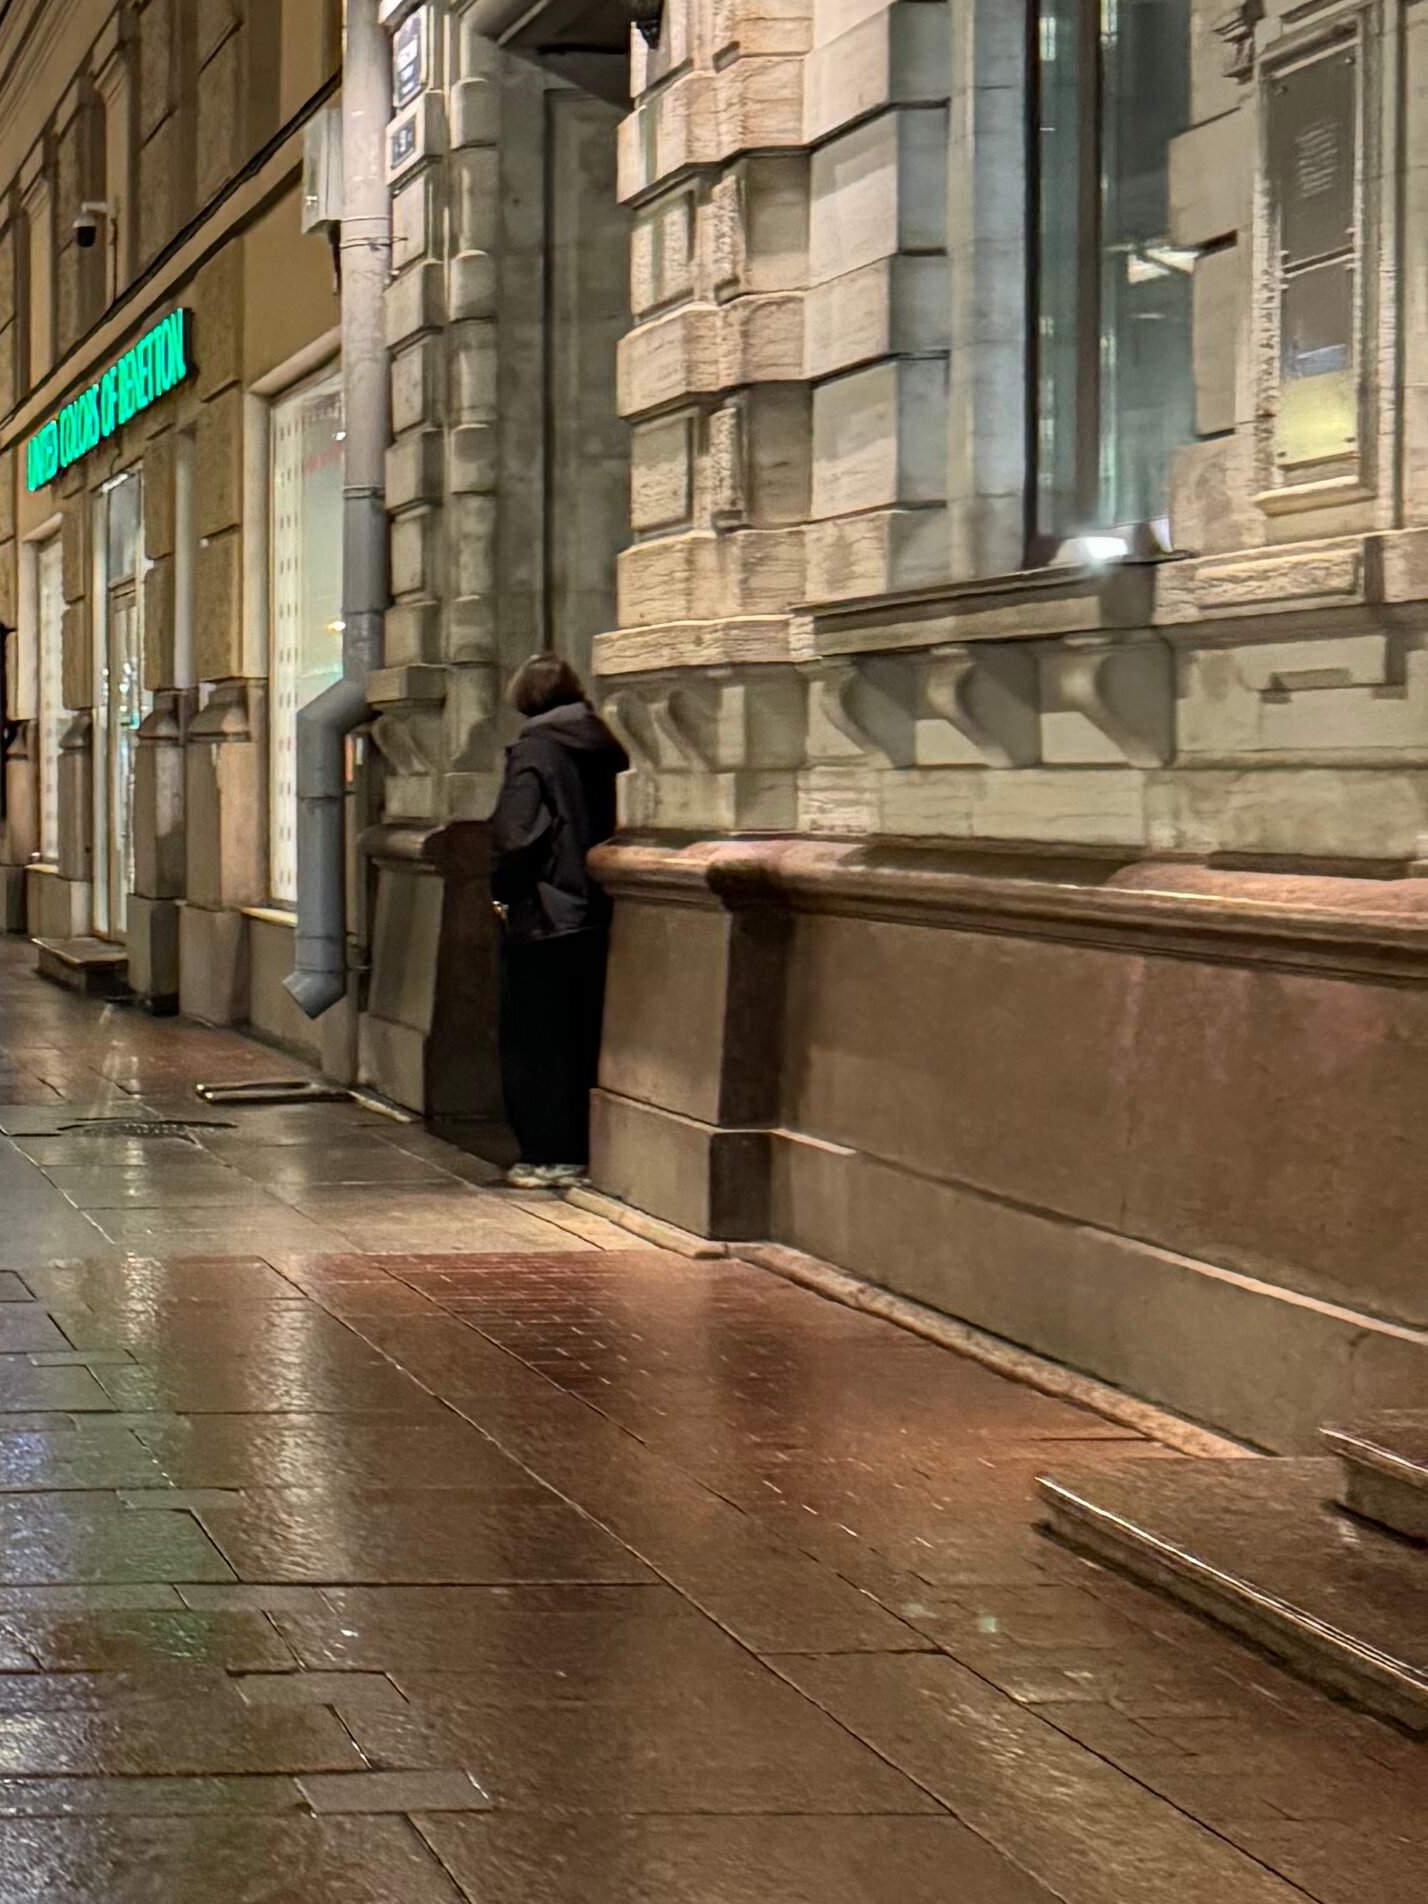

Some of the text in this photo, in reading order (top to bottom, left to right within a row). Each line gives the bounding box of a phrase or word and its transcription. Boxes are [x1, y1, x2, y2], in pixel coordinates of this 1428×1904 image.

[26, 420, 59, 492] UNITED
[58, 383, 100, 468] COLORS
[100, 366, 118, 437] OF
